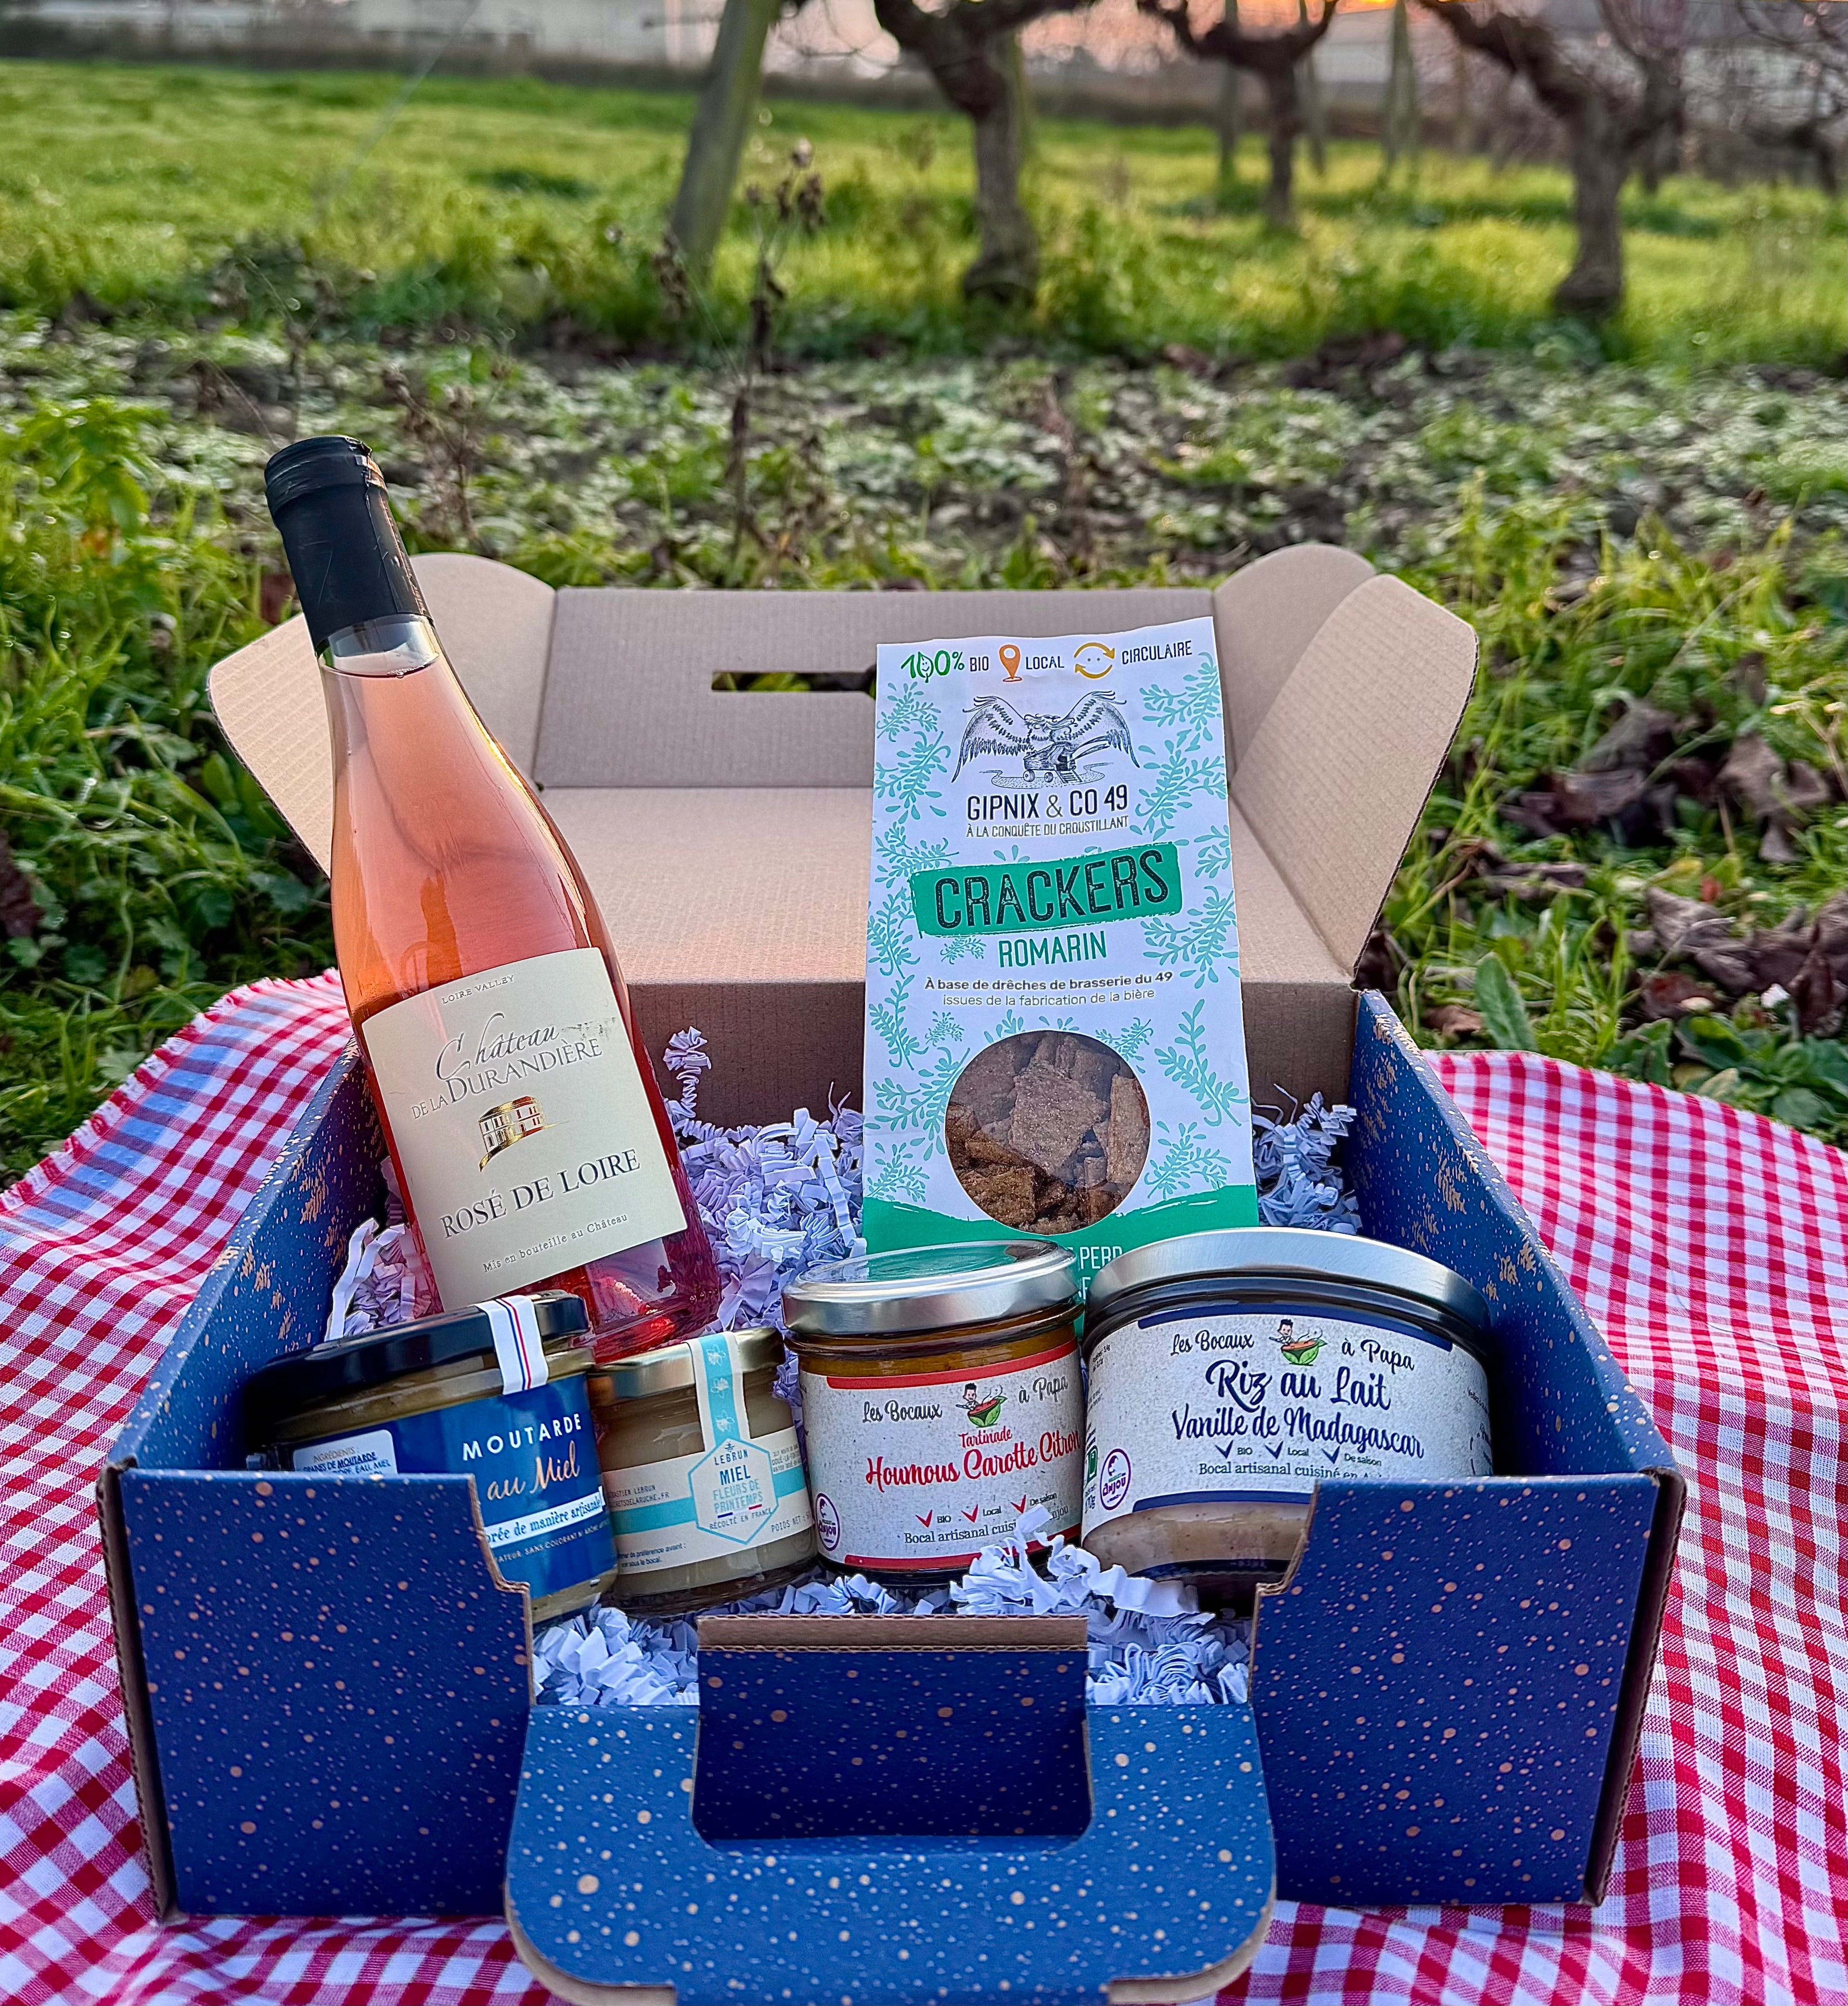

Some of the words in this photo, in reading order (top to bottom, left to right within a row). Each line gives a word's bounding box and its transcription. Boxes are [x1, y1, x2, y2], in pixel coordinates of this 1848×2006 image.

[970, 656, 989, 672] BIO
[1026, 655, 1065, 670] LOCAL
[1121, 640, 1193, 665] CIRCULAIRE
[967, 792, 1040, 820] GIPNIX
[1046, 795, 1063, 818] &
[1069, 789, 1098, 816] CO
[1104, 784, 1129, 813] 49
[966, 824, 974, 838] À
[976, 825, 989, 837] LA
[991, 822, 1041, 837] CONQUÊTE
[1044, 824, 1057, 836] DU
[1059, 816, 1129, 835] CROUSTILLANT
[934, 849, 1168, 929] CRACKERS
[998, 931, 1107, 968] ROMARIN
[441, 988, 472, 1005] LOIRE
[475, 975, 514, 992] VALLEY
[924, 977, 935, 989] À
[937, 979, 970, 990] base
[972, 978, 989, 990] de
[992, 977, 1047, 991] drêches
[1050, 978, 1066, 990] de
[1069, 975, 1132, 989] brasserie
[1134, 973, 1153, 985] du
[1155, 971, 1173, 983] 49
[942, 994, 982, 1007] issues
[986, 994, 1002, 1006] de
[1005, 993, 1016, 1005] la
[1019, 993, 1087, 1006] fabrication
[1090, 991, 1107, 1004] de
[1110, 991, 1121, 1002] la
[1124, 988, 1155, 1001] bière
[436, 1012, 559, 1081] Château
[411, 1105, 429, 1119] DE
[429, 1094, 449, 1113] LA
[446, 1038, 603, 1104] DURANDIÈRE
[440, 1189, 507, 1239] ROSÉ
[510, 1177, 554, 1212] DE
[557, 1149, 641, 1193] LOIRE
[483, 1259, 501, 1273] Mis
[504, 1254, 516, 1265] en
[518, 1234, 567, 1259] bouteille
[570, 1228, 584, 1239] au
[586, 1214, 628, 1236] Château
[1170, 1334, 1193, 1356] Les
[1195, 1329, 1254, 1352] Bocaux
[1342, 1339, 1355, 1356] à
[1360, 1339, 1414, 1371] Papa
[862, 1401, 883, 1423] Les
[885, 1399, 942, 1422] Bocaux
[1019, 1385, 1029, 1404] à
[1032, 1374, 1068, 1402] Papa
[1206, 1360, 1272, 1412] Riz
[1280, 1373, 1321, 1398] au
[1330, 1366, 1391, 1411] Lait
[462, 1413, 582, 1461] MOUTARDE
[958, 1425, 1012, 1448] Tartinade
[1172, 1404, 1248, 1441] Vanille
[1252, 1405, 1280, 1436] de
[1283, 1406, 1425, 1460] Madagascar
[714, 1449, 748, 1465] LEBRUN
[865, 1456, 961, 1493] Houmous
[963, 1442, 1038, 1481] Carotte
[1039, 1429, 1081, 1461] Citron
[1199, 1461, 1232, 1475] Bocal
[1234, 1462, 1291, 1475] artisanal
[1294, 1464, 1340, 1479] cuisiné
[1287, 1447, 1309, 1457] Local
[1344, 1453, 1355, 1462] De
[1356, 1456, 1382, 1467] saison
[487, 1477, 526, 1501] au
[528, 1440, 580, 1494] Miel
[719, 1465, 751, 1485] MIEL
[713, 1482, 746, 1501] FLEURS
[748, 1479, 760, 1490] DE
[714, 1492, 763, 1514] PRINTEMPS
[513, 1522, 526, 1536] de
[529, 1512, 568, 1531] manière
[752, 1508, 771, 1519] FRANCE
[937, 1516, 951, 1524] BIO
[983, 1506, 1001, 1517] Local
[1029, 1498, 1039, 1506] De
[771, 1520, 790, 1532] POIDS
[904, 1531, 935, 1544] Bocal
[938, 1525, 988, 1542] artisanal
[991, 1519, 1016, 1535] cuisi
[1050, 1505, 1069, 1520] njou
